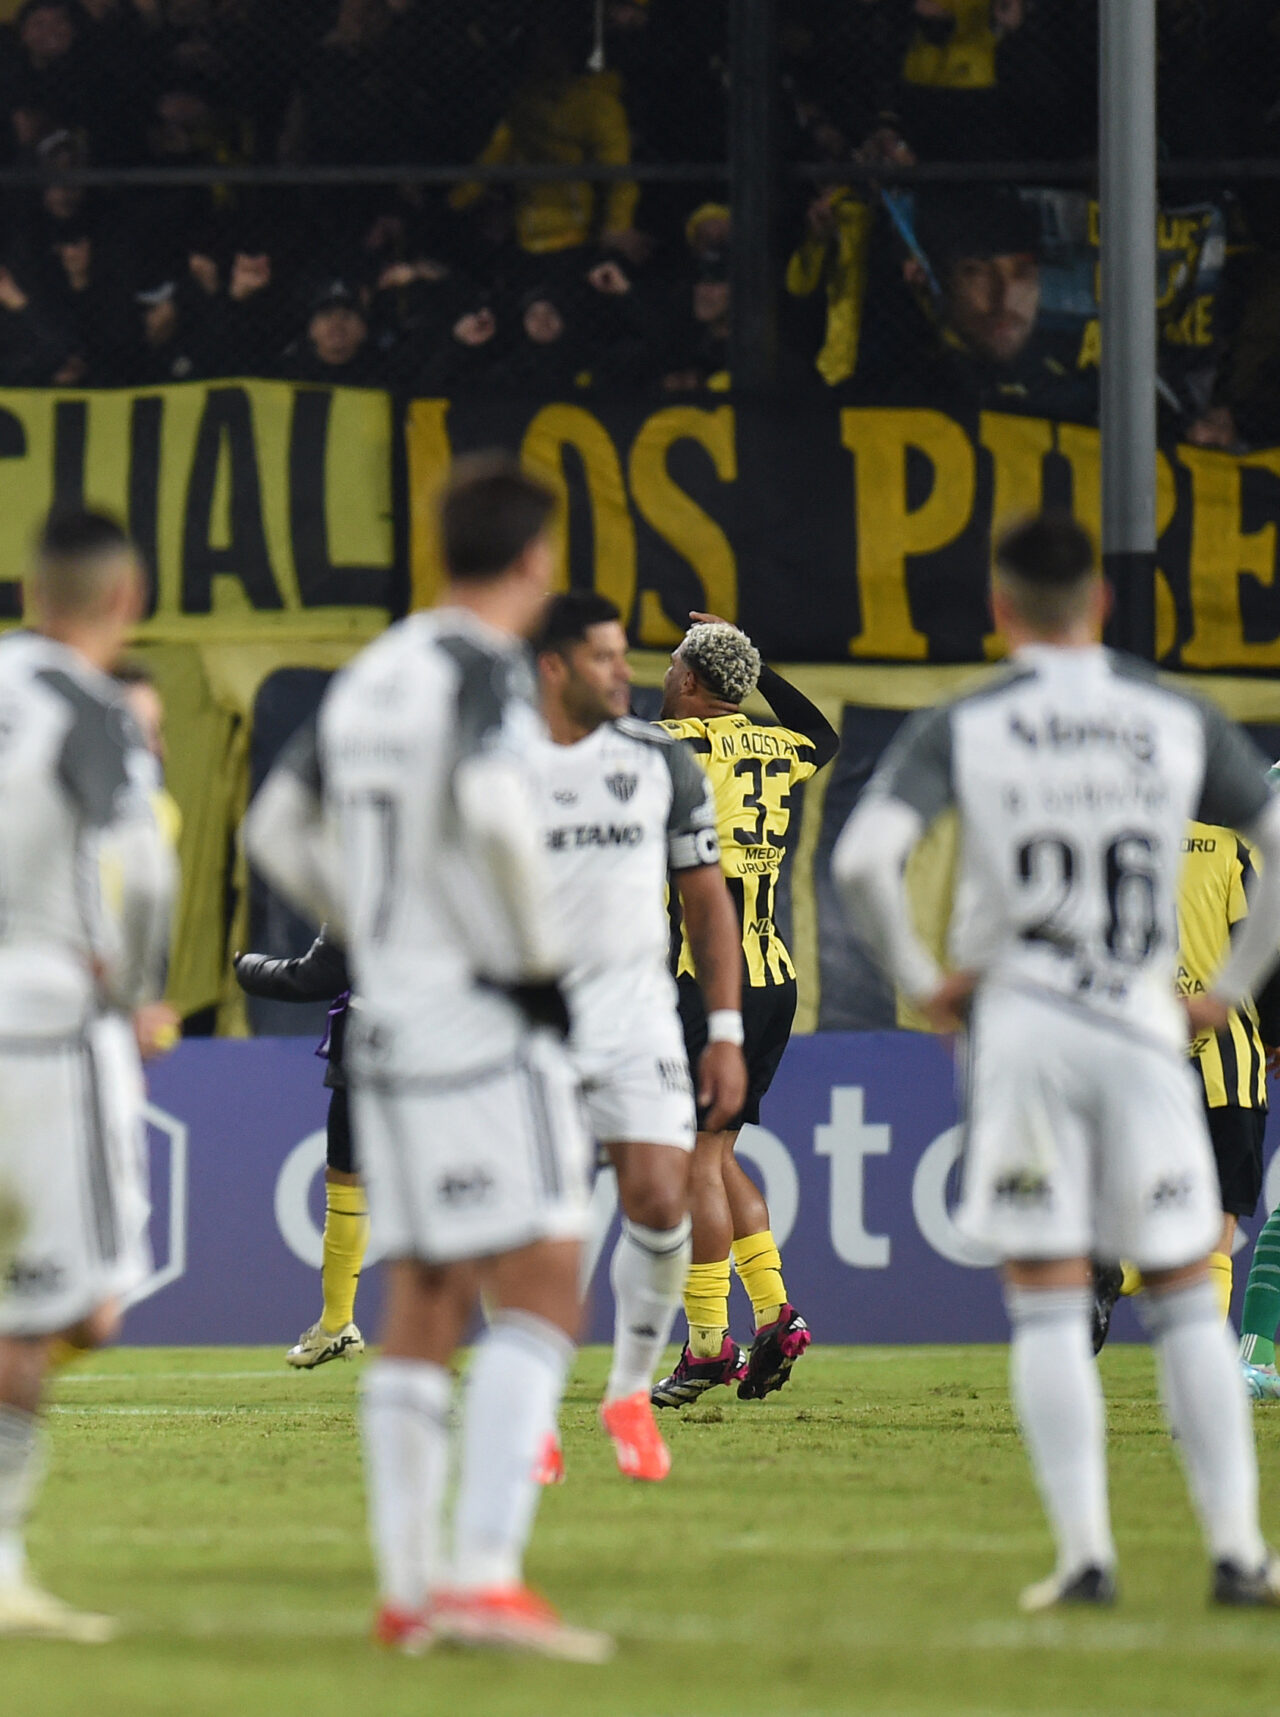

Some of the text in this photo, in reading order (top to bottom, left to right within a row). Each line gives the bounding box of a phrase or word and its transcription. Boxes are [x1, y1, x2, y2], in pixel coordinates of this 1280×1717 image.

[741, 732, 795, 757] ACOSTA
[745, 847, 781, 860] MEDI
[736, 861, 778, 875] URUG
[1014, 828, 1164, 966] 26
